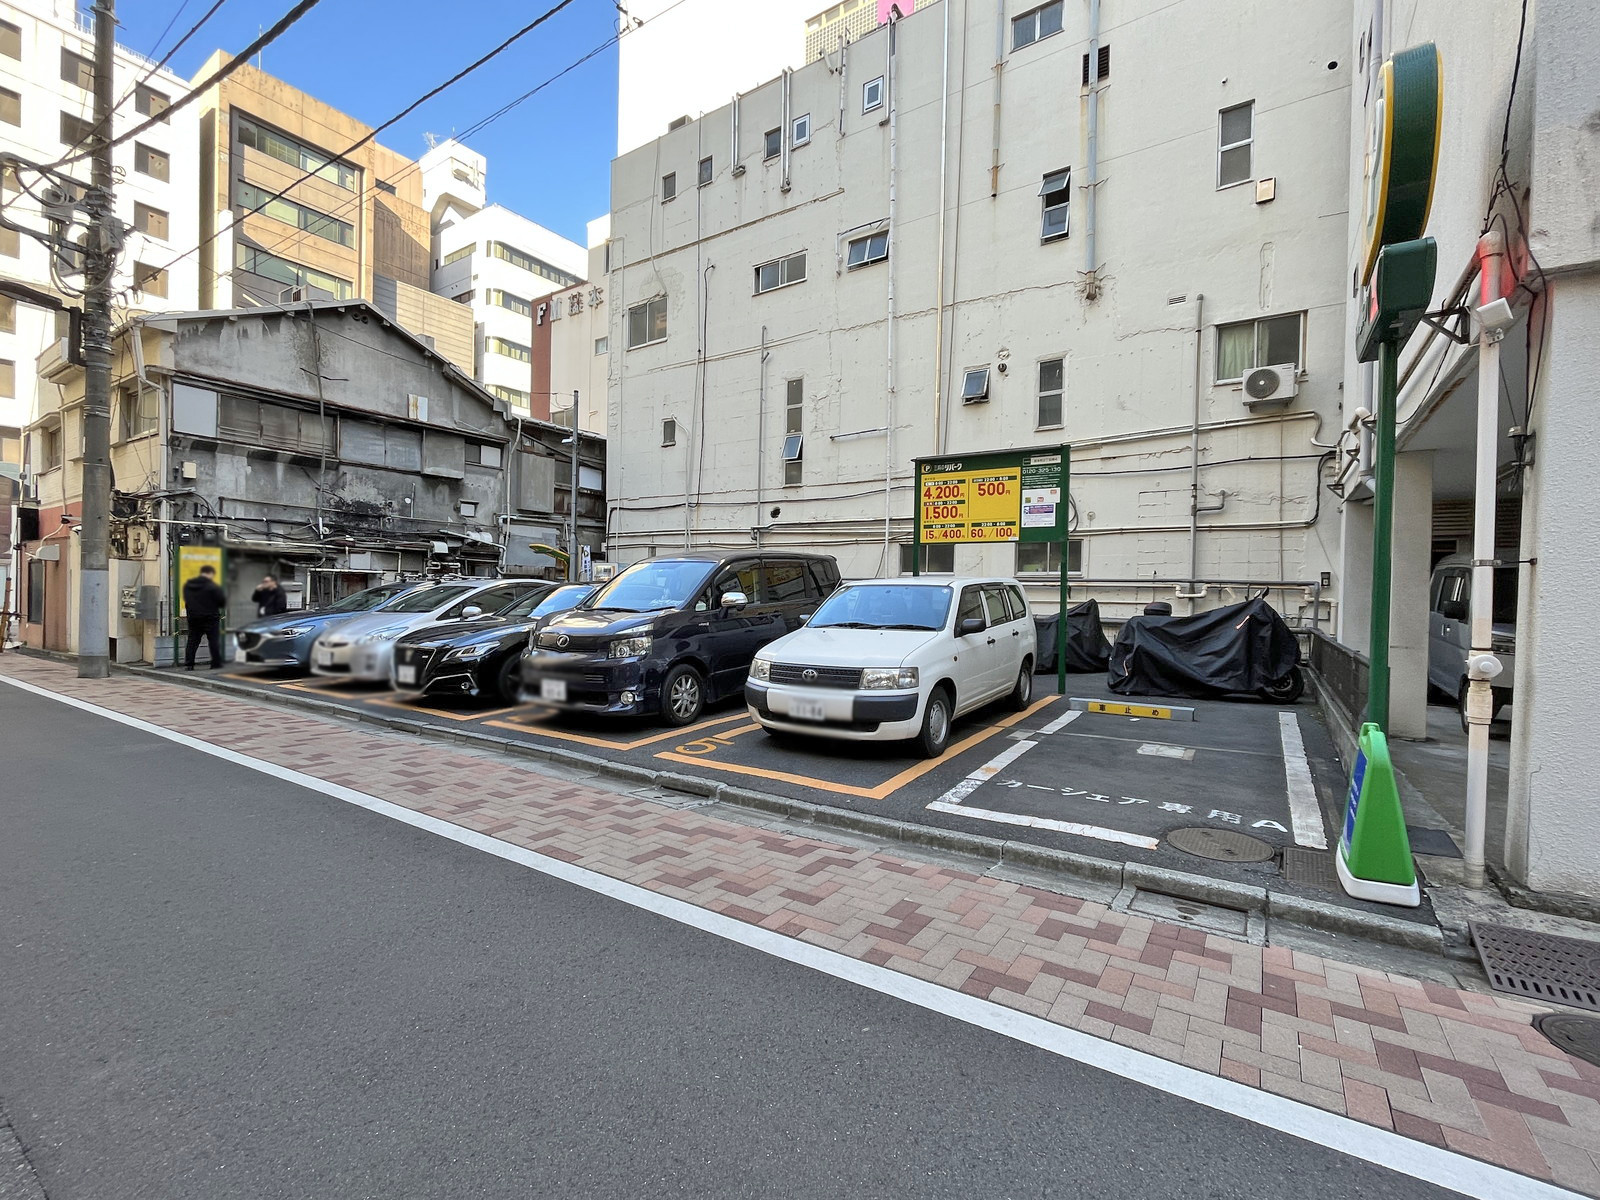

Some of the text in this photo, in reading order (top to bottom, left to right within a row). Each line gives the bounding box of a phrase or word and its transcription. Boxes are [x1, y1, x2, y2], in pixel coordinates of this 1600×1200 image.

[978, 482, 1011, 497] 500円
[1098, 704, 1160, 717] 車止め
